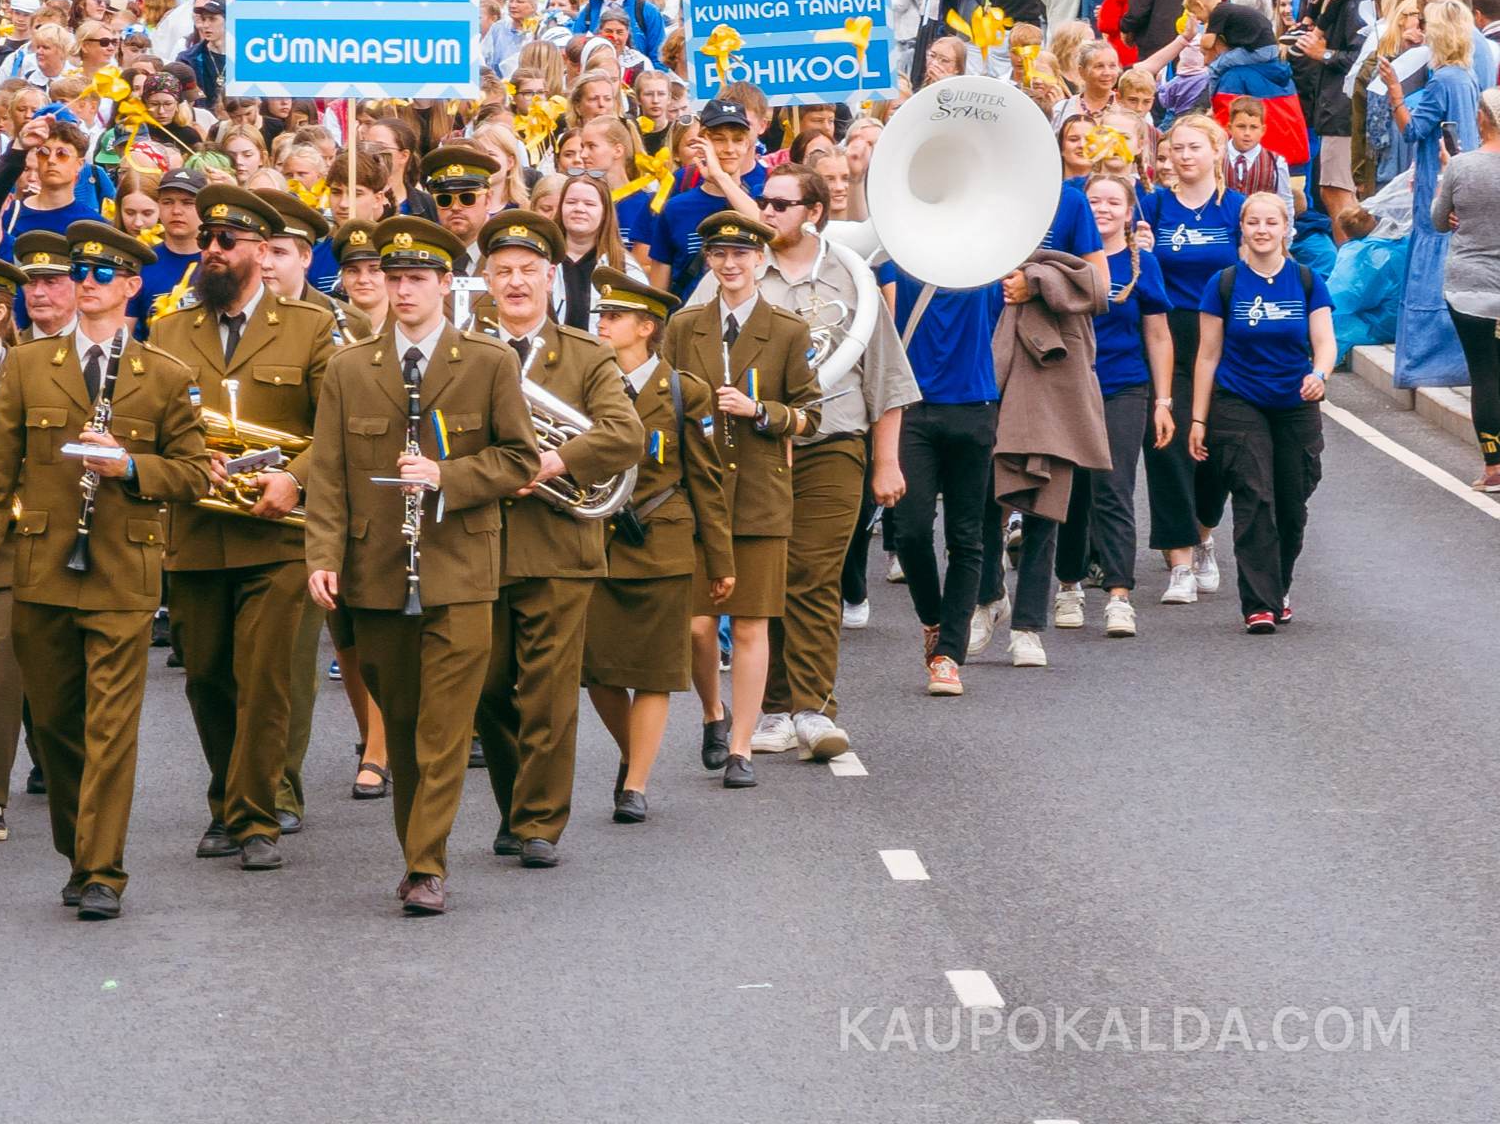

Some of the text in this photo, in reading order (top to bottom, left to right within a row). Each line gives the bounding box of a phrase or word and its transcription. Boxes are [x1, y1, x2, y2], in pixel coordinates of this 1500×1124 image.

[695, 1, 789, 23] KUNINGA
[245, 29, 460, 66] GÜMNAASIUM
[952, 89, 1006, 107] JUPITER
